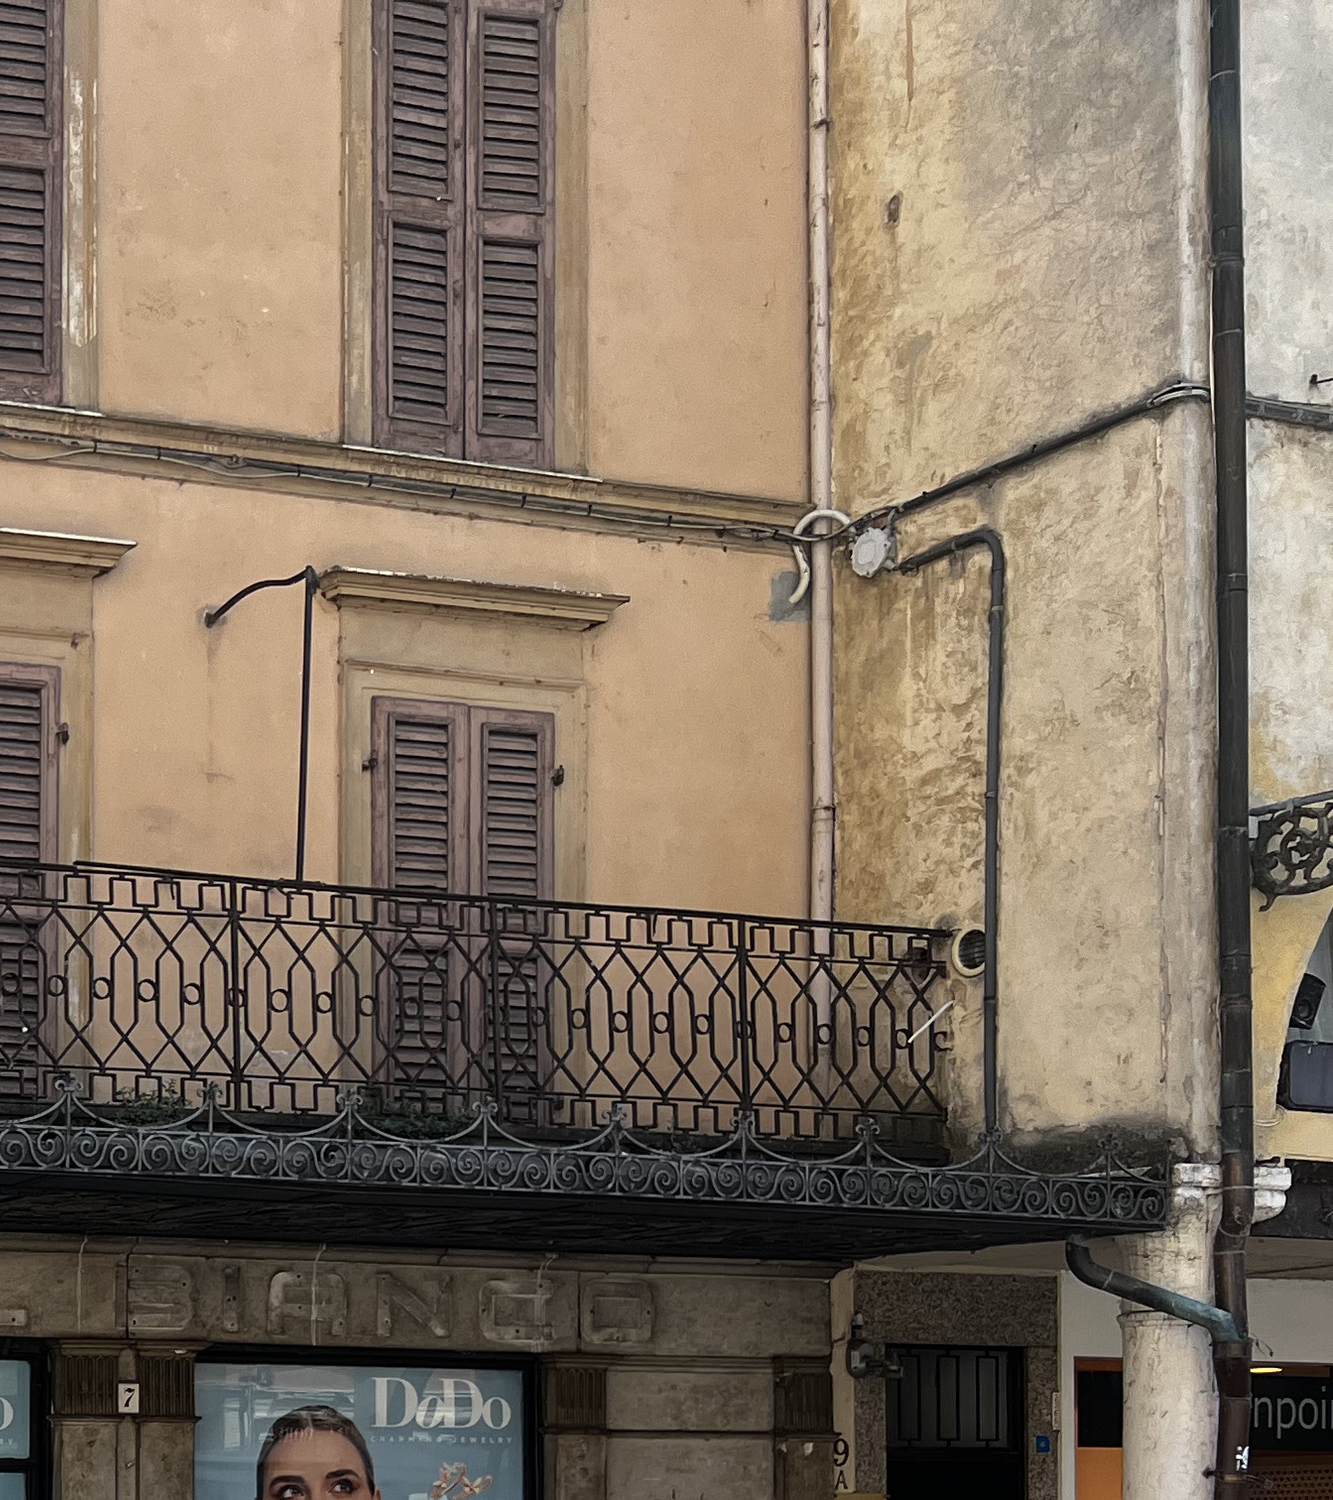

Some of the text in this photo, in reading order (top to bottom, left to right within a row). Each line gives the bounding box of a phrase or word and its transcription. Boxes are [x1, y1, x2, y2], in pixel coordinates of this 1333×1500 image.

[115, 1262, 654, 1343] BIANCO
[124, 1388, 135, 1407] 7
[370, 1376, 512, 1430] DoDo
[1254, 1385, 1333, 1439] npoi
[833, 1438, 849, 1466] 9
[834, 1470, 848, 1490] A
